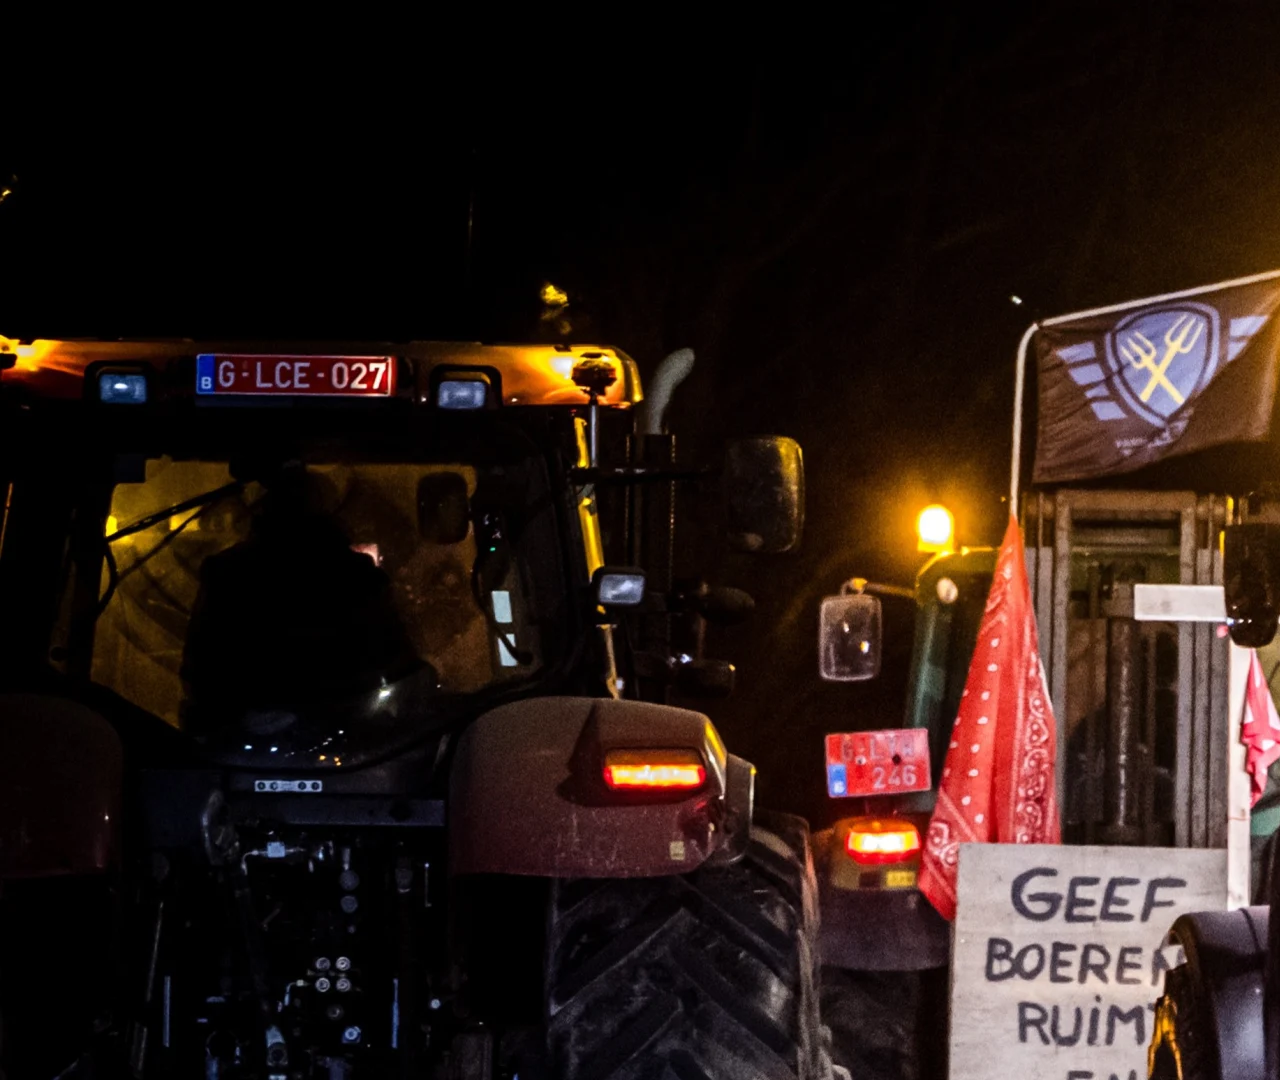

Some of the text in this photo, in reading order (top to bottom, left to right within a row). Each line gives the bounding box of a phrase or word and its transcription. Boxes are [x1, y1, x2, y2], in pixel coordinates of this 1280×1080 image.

[201, 360, 387, 390] B G-LCE-027
[873, 764, 917, 789] 246
[1011, 867, 1187, 923] GEEF
